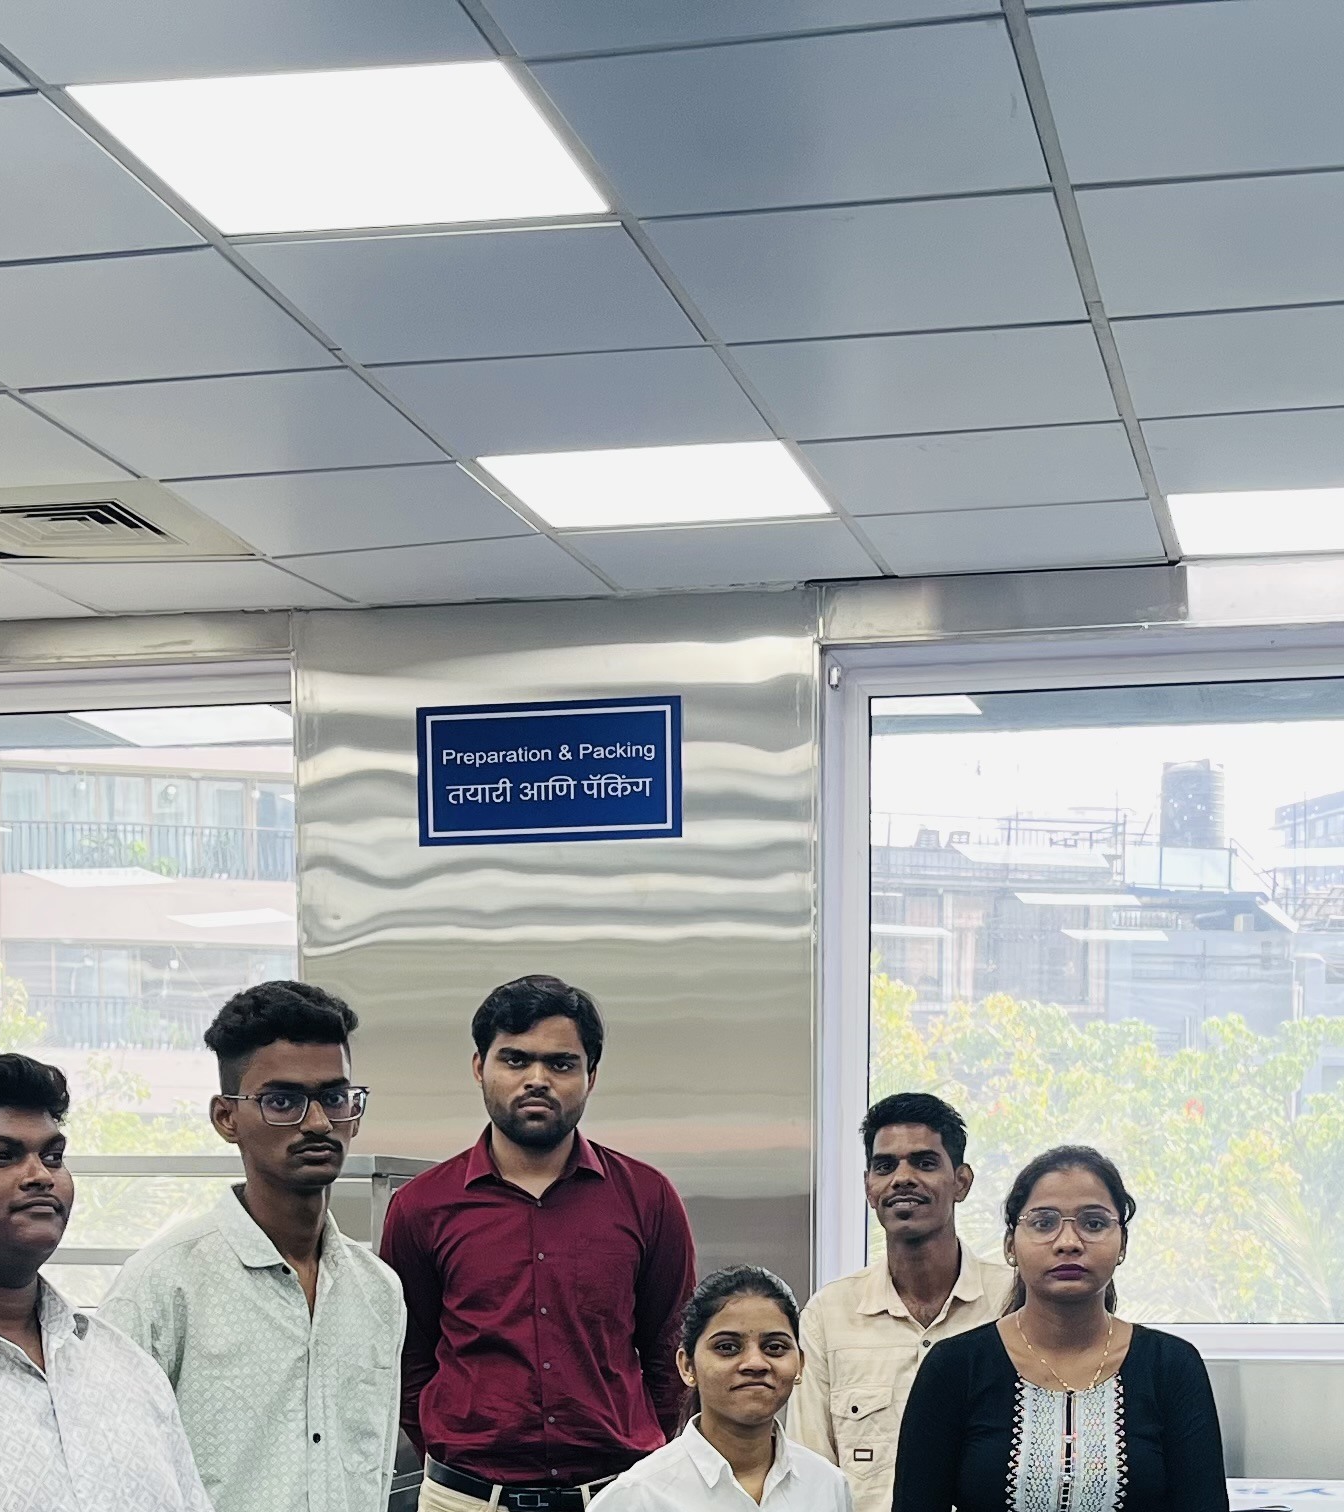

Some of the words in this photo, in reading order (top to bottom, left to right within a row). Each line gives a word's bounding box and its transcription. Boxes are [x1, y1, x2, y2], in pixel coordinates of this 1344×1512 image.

[442, 747, 551, 767] Preparation
[558, 745, 572, 760] &
[579, 742, 655, 761] Packing
[446, 778, 512, 804] तयारी
[519, 775, 577, 800] आणि
[581, 773, 652, 798] पॅकिंग
